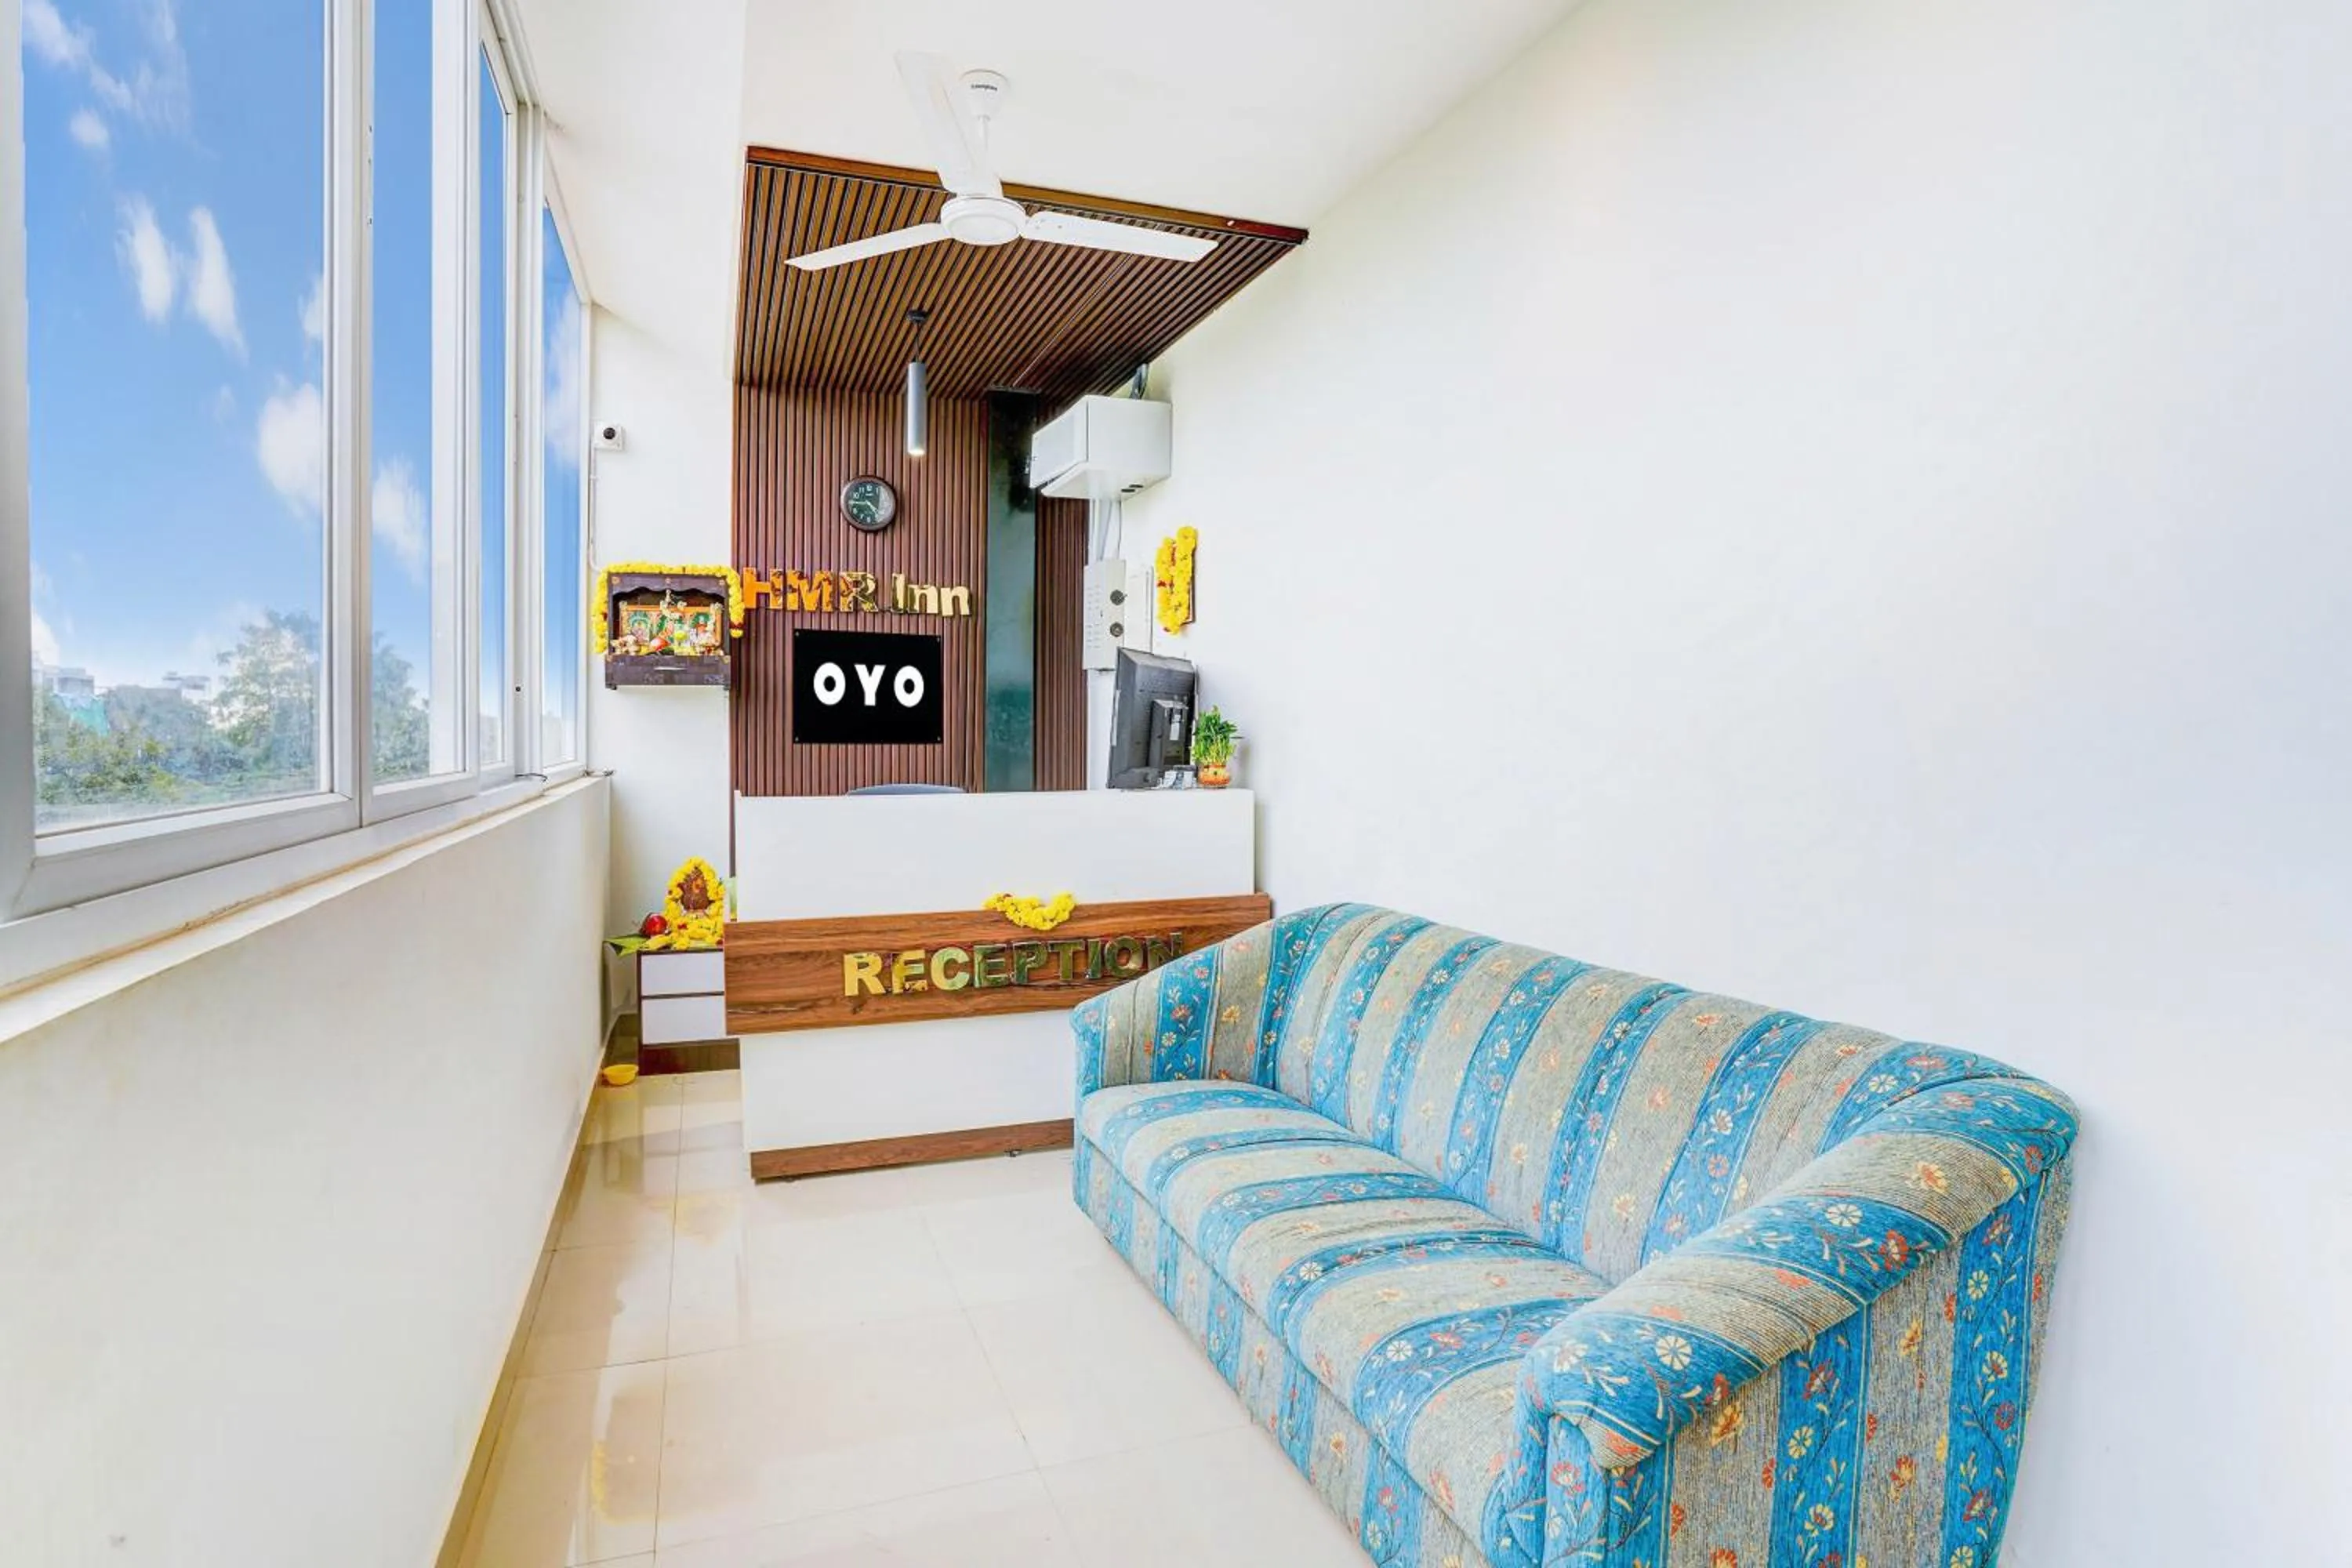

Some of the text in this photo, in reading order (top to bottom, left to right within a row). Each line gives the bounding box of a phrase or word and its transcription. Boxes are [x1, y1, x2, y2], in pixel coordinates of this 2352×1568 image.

[742, 567, 971, 617] HMR Inn
[813, 662, 924, 708] OYO
[843, 932, 1184, 996] RECEPTION
